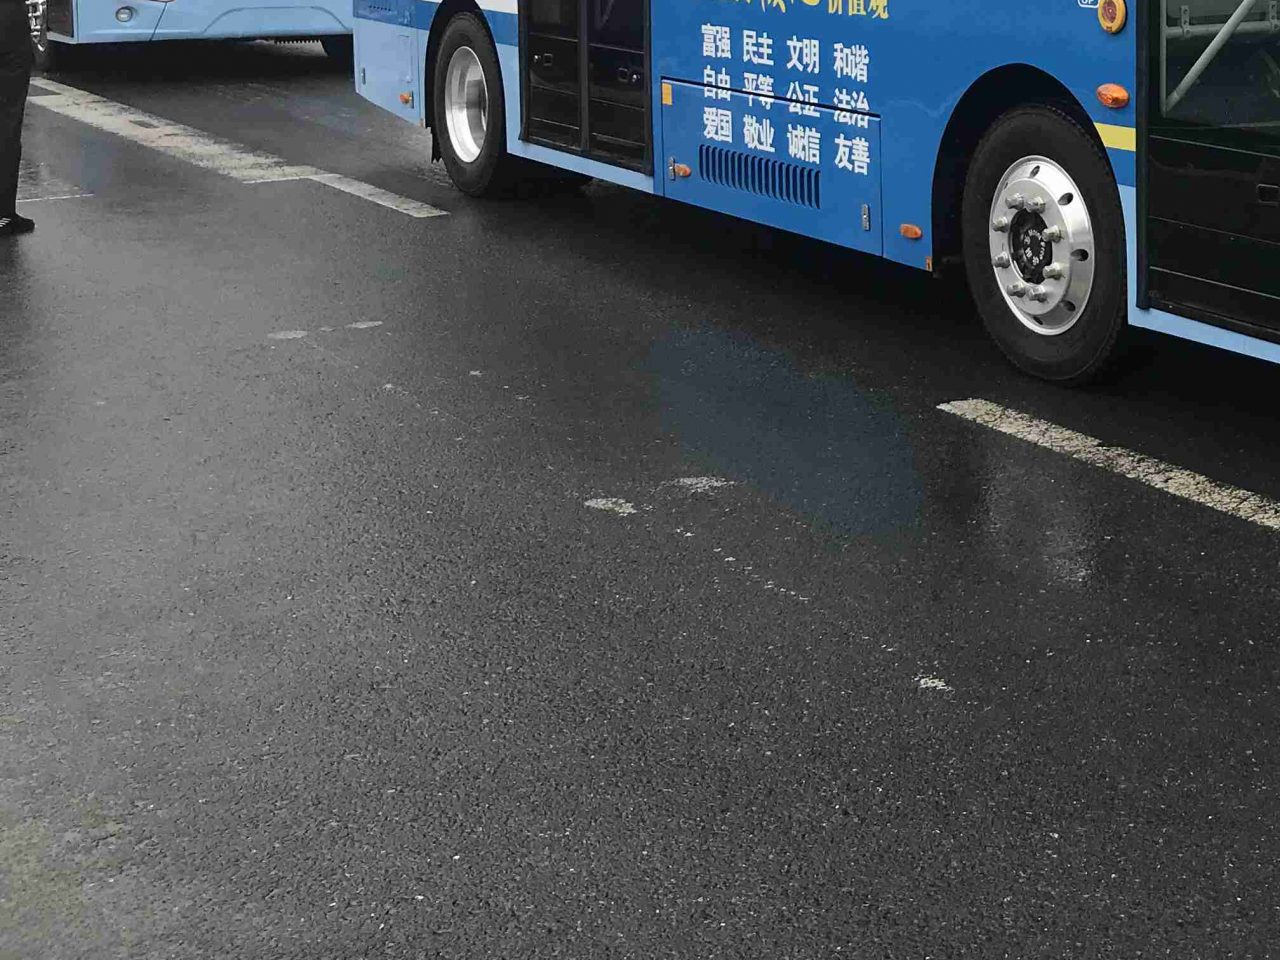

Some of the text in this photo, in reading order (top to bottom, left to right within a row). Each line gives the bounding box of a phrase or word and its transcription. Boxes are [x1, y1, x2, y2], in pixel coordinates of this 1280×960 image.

[701, 23, 869, 83] 富强 民主 文明 和谐
[703, 65, 869, 128] 自由 平等 公正 法治
[703, 107, 870, 176] 爱国 敬业 诚信 友善
